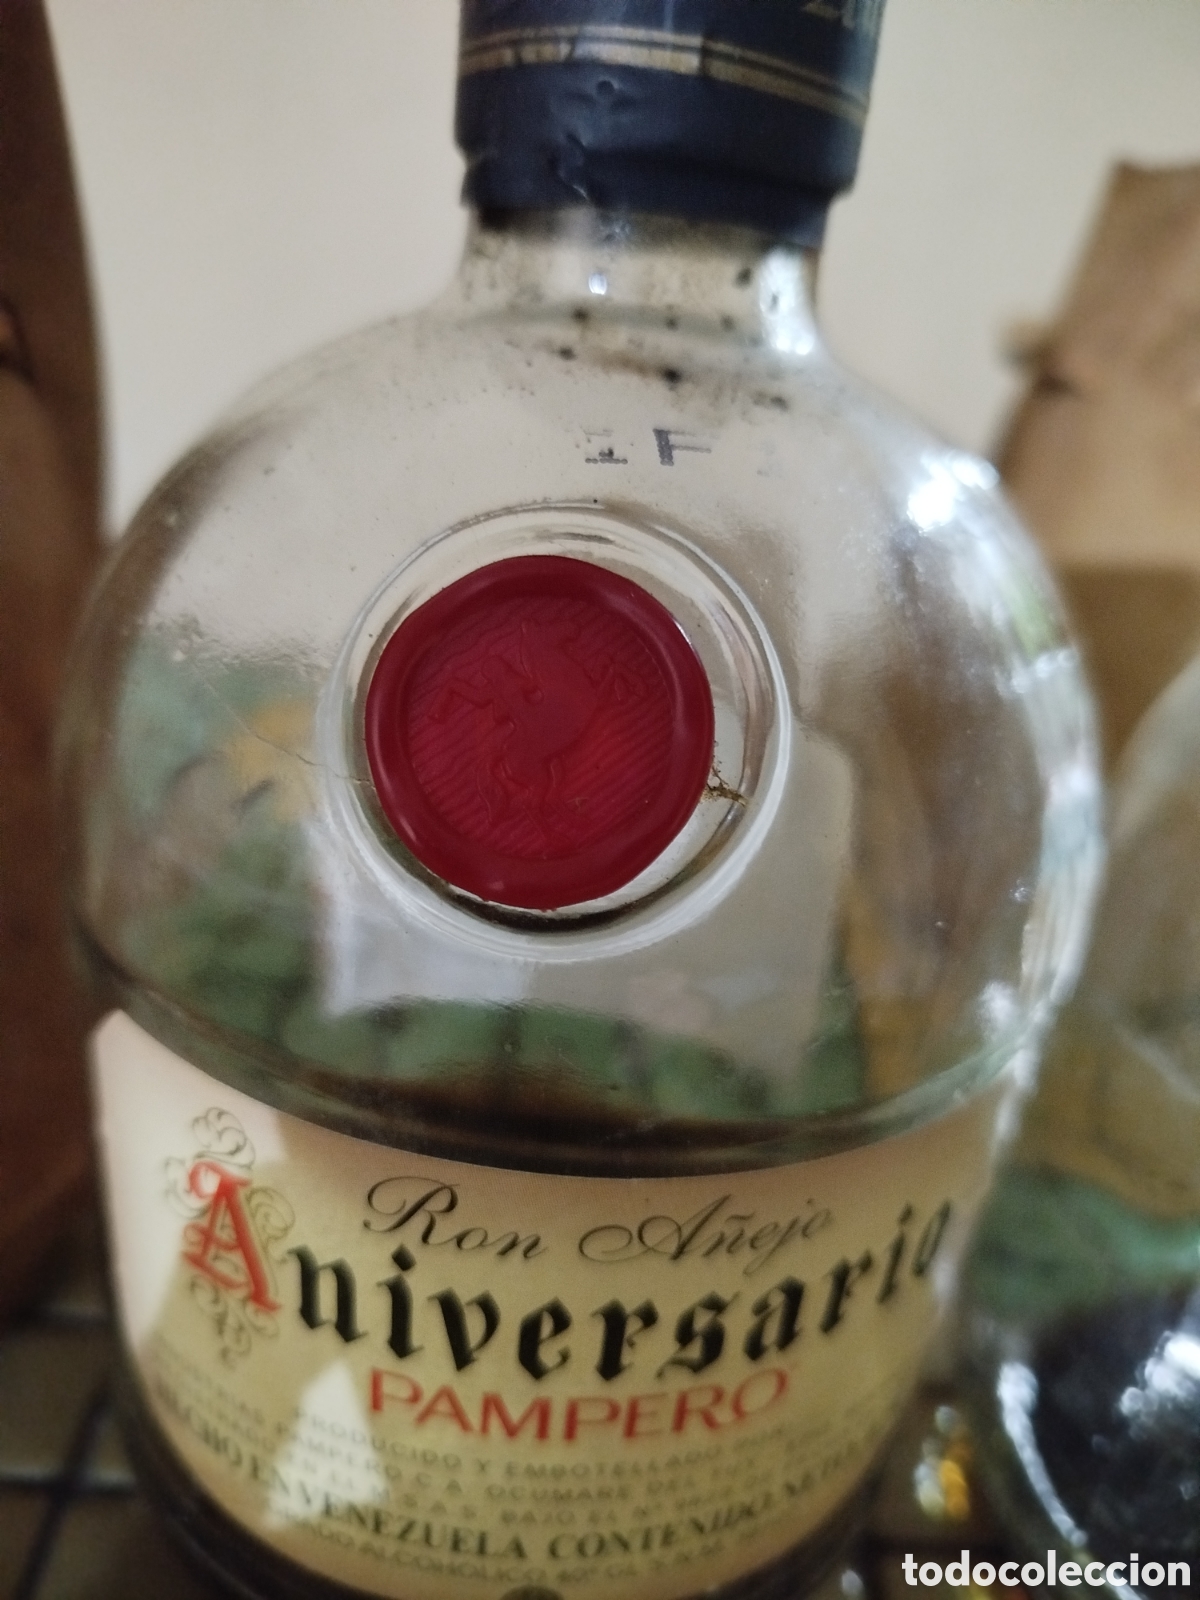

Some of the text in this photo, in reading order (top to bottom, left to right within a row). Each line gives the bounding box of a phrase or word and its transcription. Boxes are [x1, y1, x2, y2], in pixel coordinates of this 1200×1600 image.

[182, 1160, 953, 1383] Aniversario
[363, 1175, 835, 1276] Ron Añejo
[369, 1367, 790, 1443] PAMPERO
[298, 1478, 529, 1562] VENEZUELA
